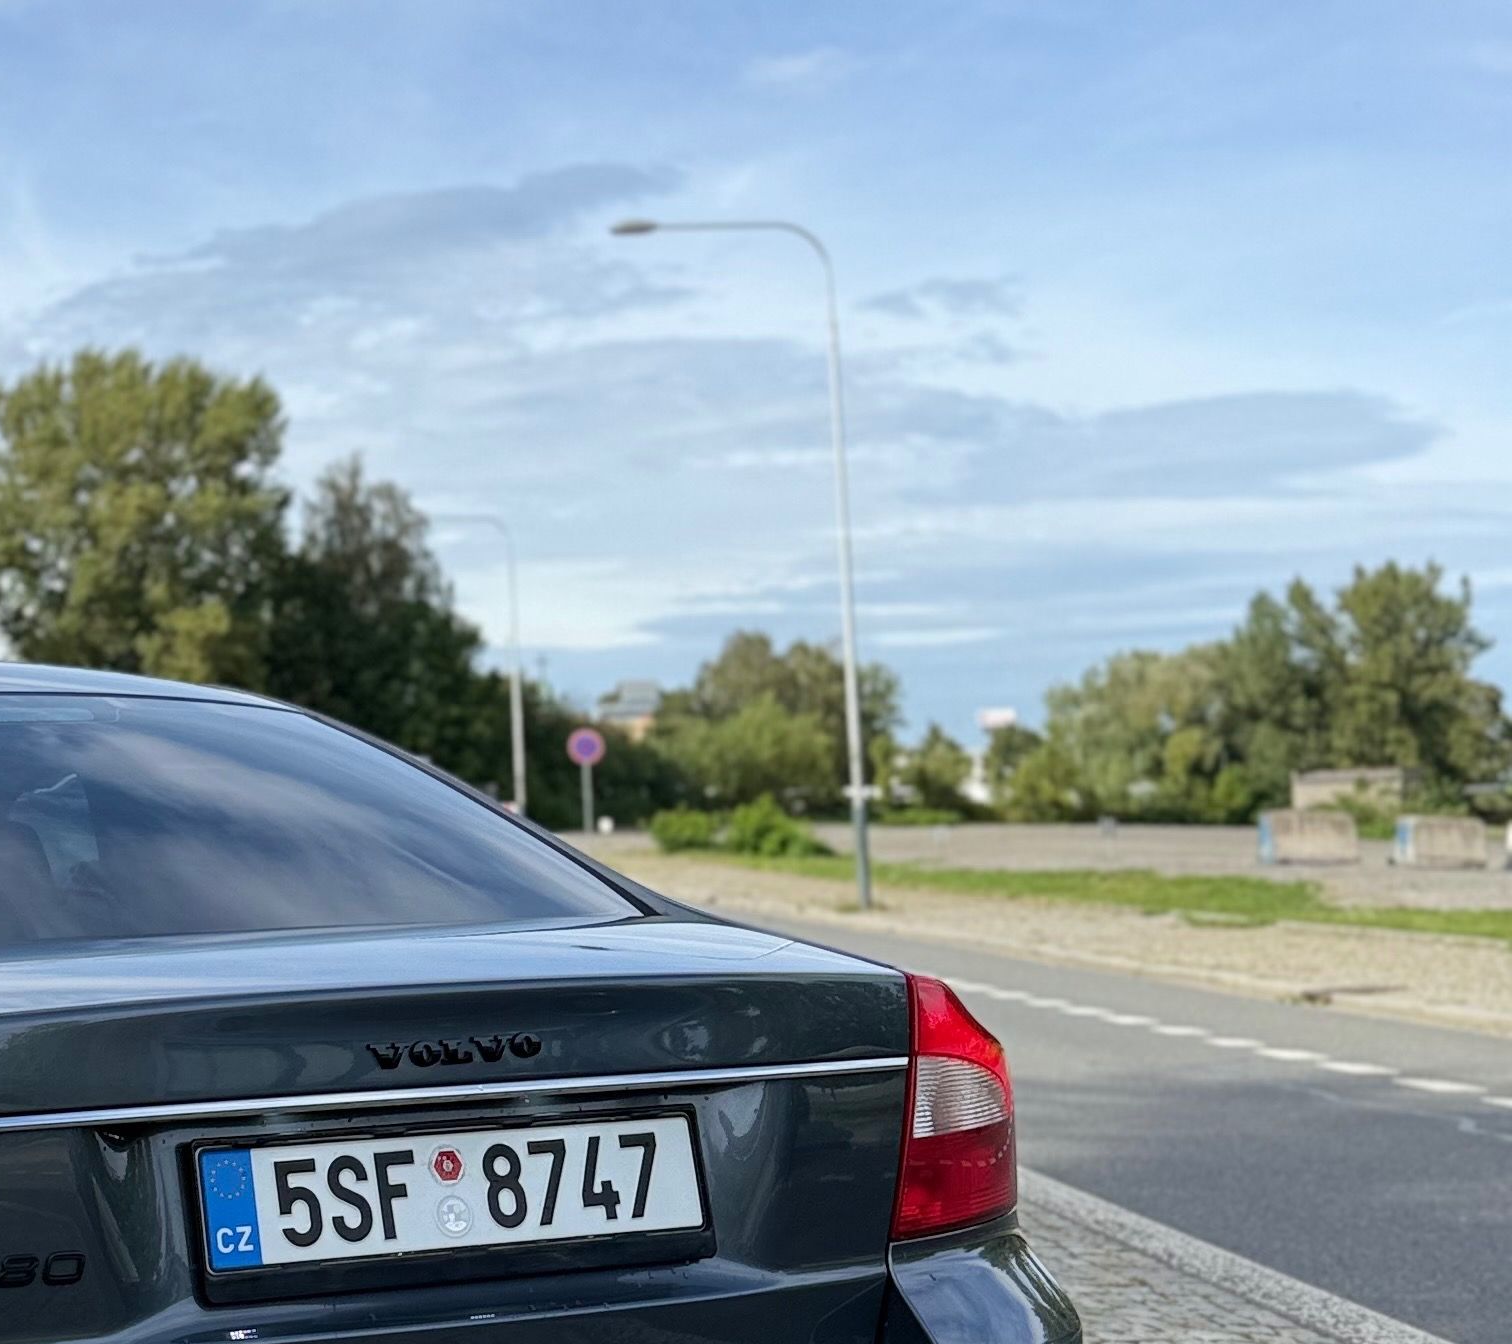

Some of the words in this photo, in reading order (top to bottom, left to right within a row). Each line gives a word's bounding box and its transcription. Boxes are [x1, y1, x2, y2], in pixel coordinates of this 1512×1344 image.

[365, 1031, 542, 1070] VOLVO
[273, 1149, 415, 1248] 5SF
[482, 1131, 656, 1229] 8747
[215, 1224, 254, 1255] CZ
